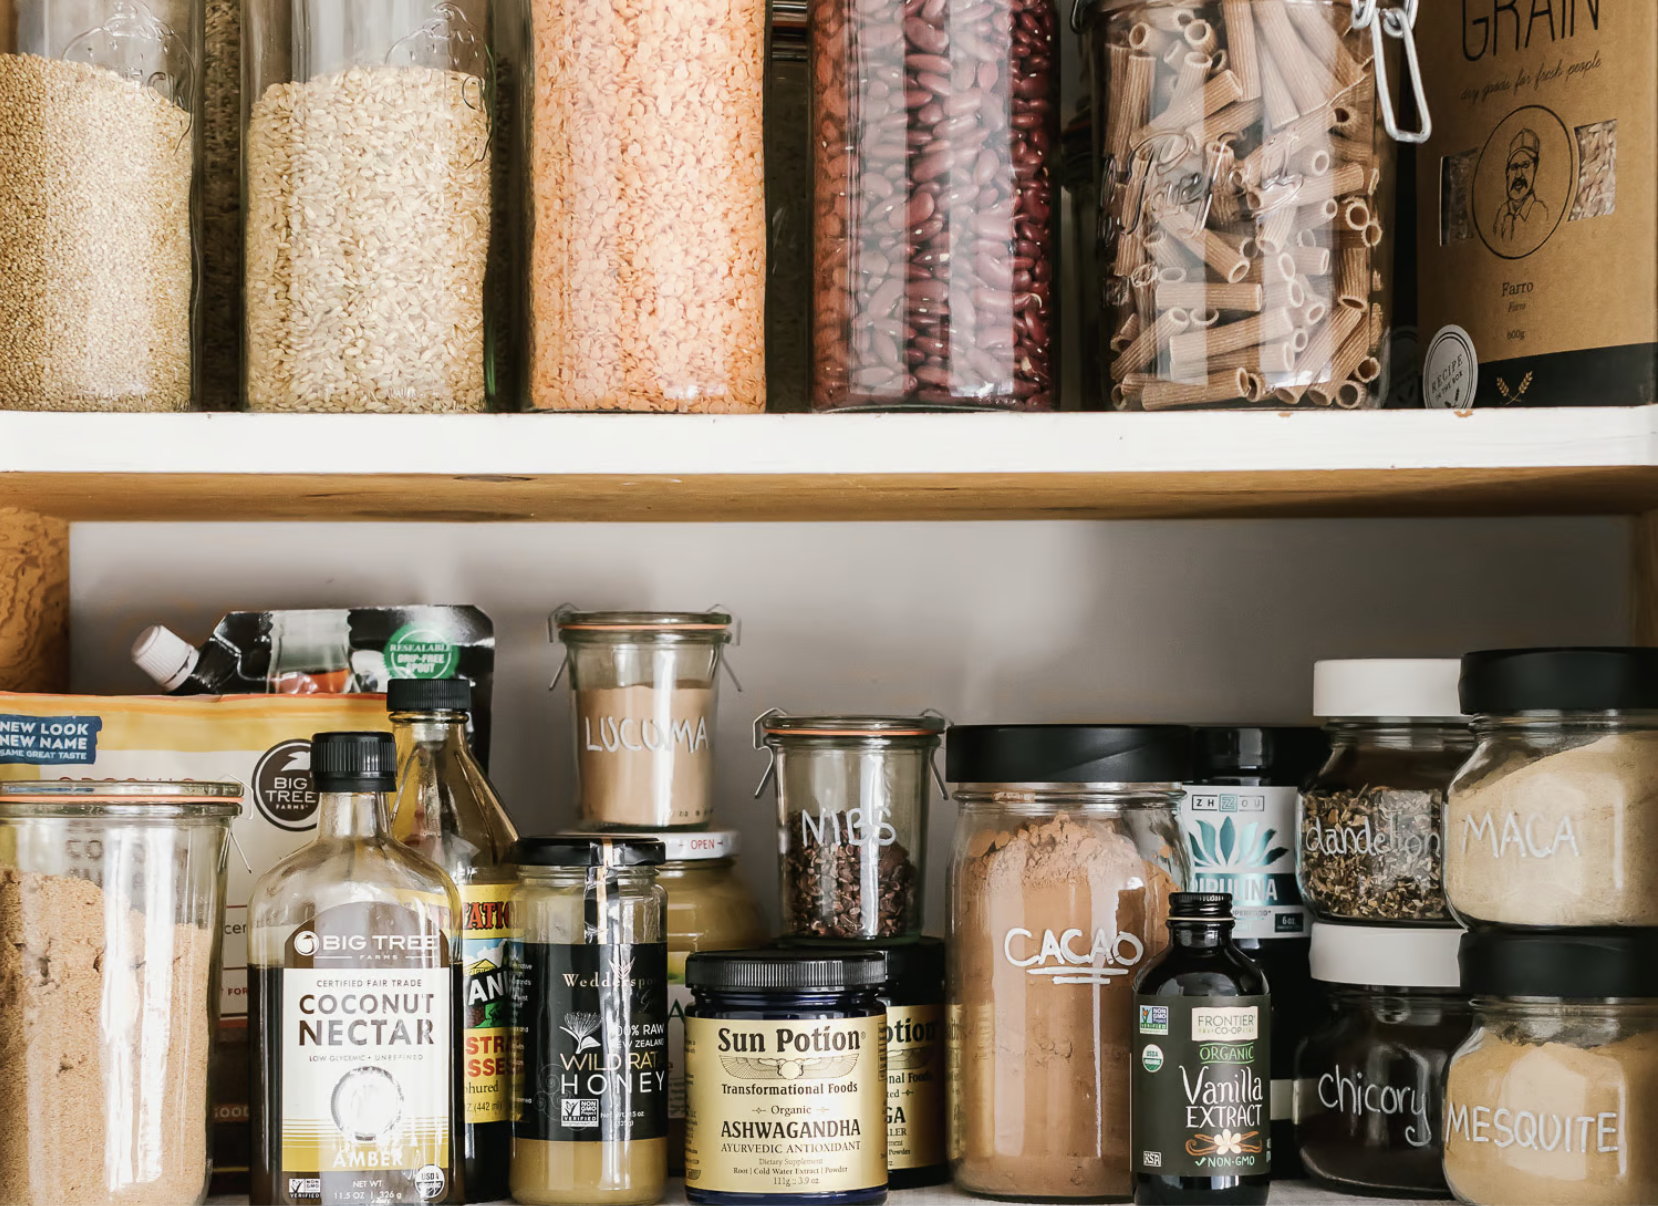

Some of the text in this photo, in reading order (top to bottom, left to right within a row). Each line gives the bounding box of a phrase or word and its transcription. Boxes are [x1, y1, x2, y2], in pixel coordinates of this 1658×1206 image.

[1501, 281, 1534, 297] Farro
[1431, 354, 1463, 394] RECIPE
[0, 721, 89, 736] NEW LOOK
[0, 734, 88, 750] NEW NAME
[0, 748, 87, 760] SAME GREAT TASTE
[274, 777, 307, 790] BIG
[265, 790, 317, 803] TREE
[802, 806, 897, 848] NIBS
[1462, 811, 1579, 859] MACA
[690, 839, 715, 850] OPEN
[1306, 816, 1442, 857] dandelion
[322, 934, 440, 950] BIG TREE
[1004, 927, 1144, 967] CACAO
[316, 979, 422, 987] CERTIFIED FAIR TRADE
[299, 993, 434, 1015] COCONUT
[1198, 1015, 1254, 1026] FRONTIER
[299, 1019, 435, 1046] NECTAR
[643, 1023, 665, 1035] RAW
[718, 1027, 766, 1052] Sun
[776, 1025, 861, 1052] Potion
[560, 1053, 621, 1071] WILD
[628, 1051, 660, 1070] RAT
[1199, 1046, 1254, 1060] ORGANIC
[561, 1071, 665, 1095] HONEY
[721, 1081, 858, 1095] Transformational Foods
[1179, 1065, 1263, 1105] Vanilla
[770, 1105, 812, 1117] Organic
[1318, 1064, 1432, 1147] chicory
[1185, 1104, 1262, 1128] EXTRACT
[721, 1119, 861, 1139] ASHWAGANDHA
[1445, 1103, 1618, 1152] MESQUITE
[721, 1141, 861, 1154] AYURVEDIC ANTIOXIDANT
[332, 1150, 403, 1169] AMBER
[758, 1158, 823, 1166] Dietary Supplement
[753, 1167, 770, 1175] Cold
[795, 1167, 820, 1175] Extract
[825, 1166, 848, 1174] Powder
[352, 1180, 367, 1188] NET
[353, 1192, 365, 1200] OZ
[379, 1191, 395, 1200] 326
